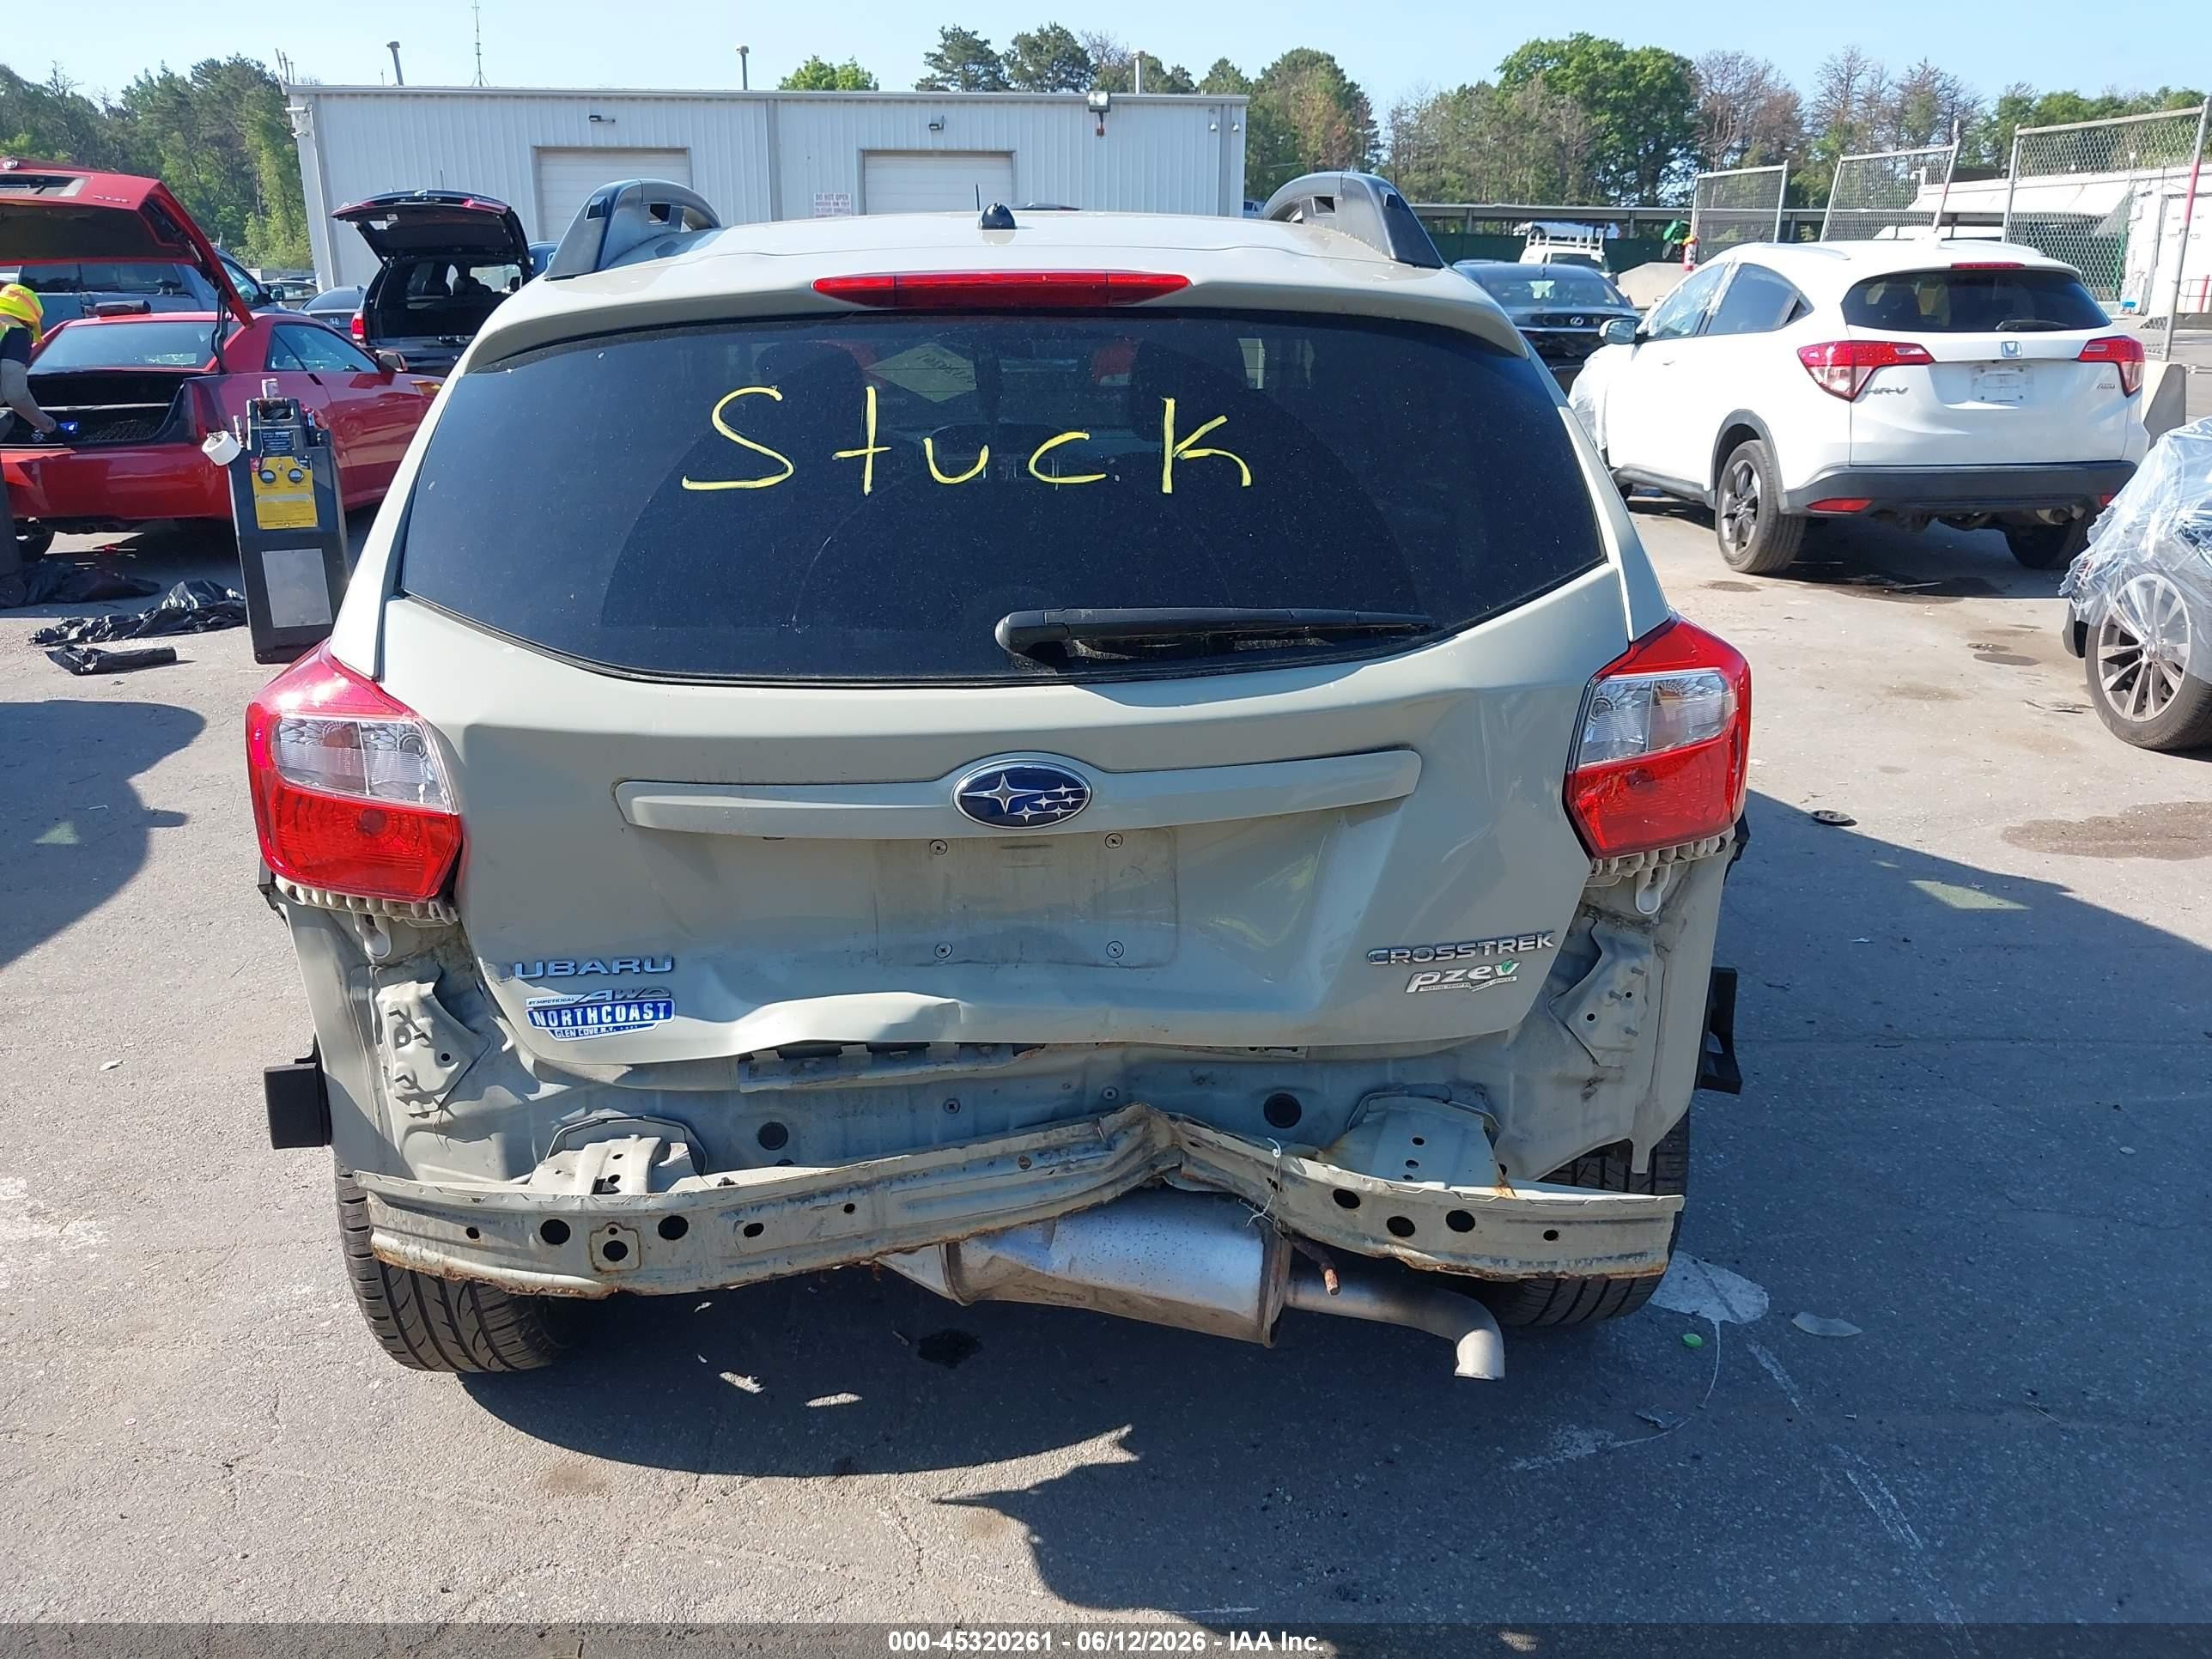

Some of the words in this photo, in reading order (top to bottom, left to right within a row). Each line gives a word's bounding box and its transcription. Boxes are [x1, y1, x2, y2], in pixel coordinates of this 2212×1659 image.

[1367, 932, 1555, 965] CROSSTREK
[578, 988, 672, 1004] AWD
[532, 1002, 667, 1028] NORTHCOAST
[555, 1029, 576, 1038] GLEN
